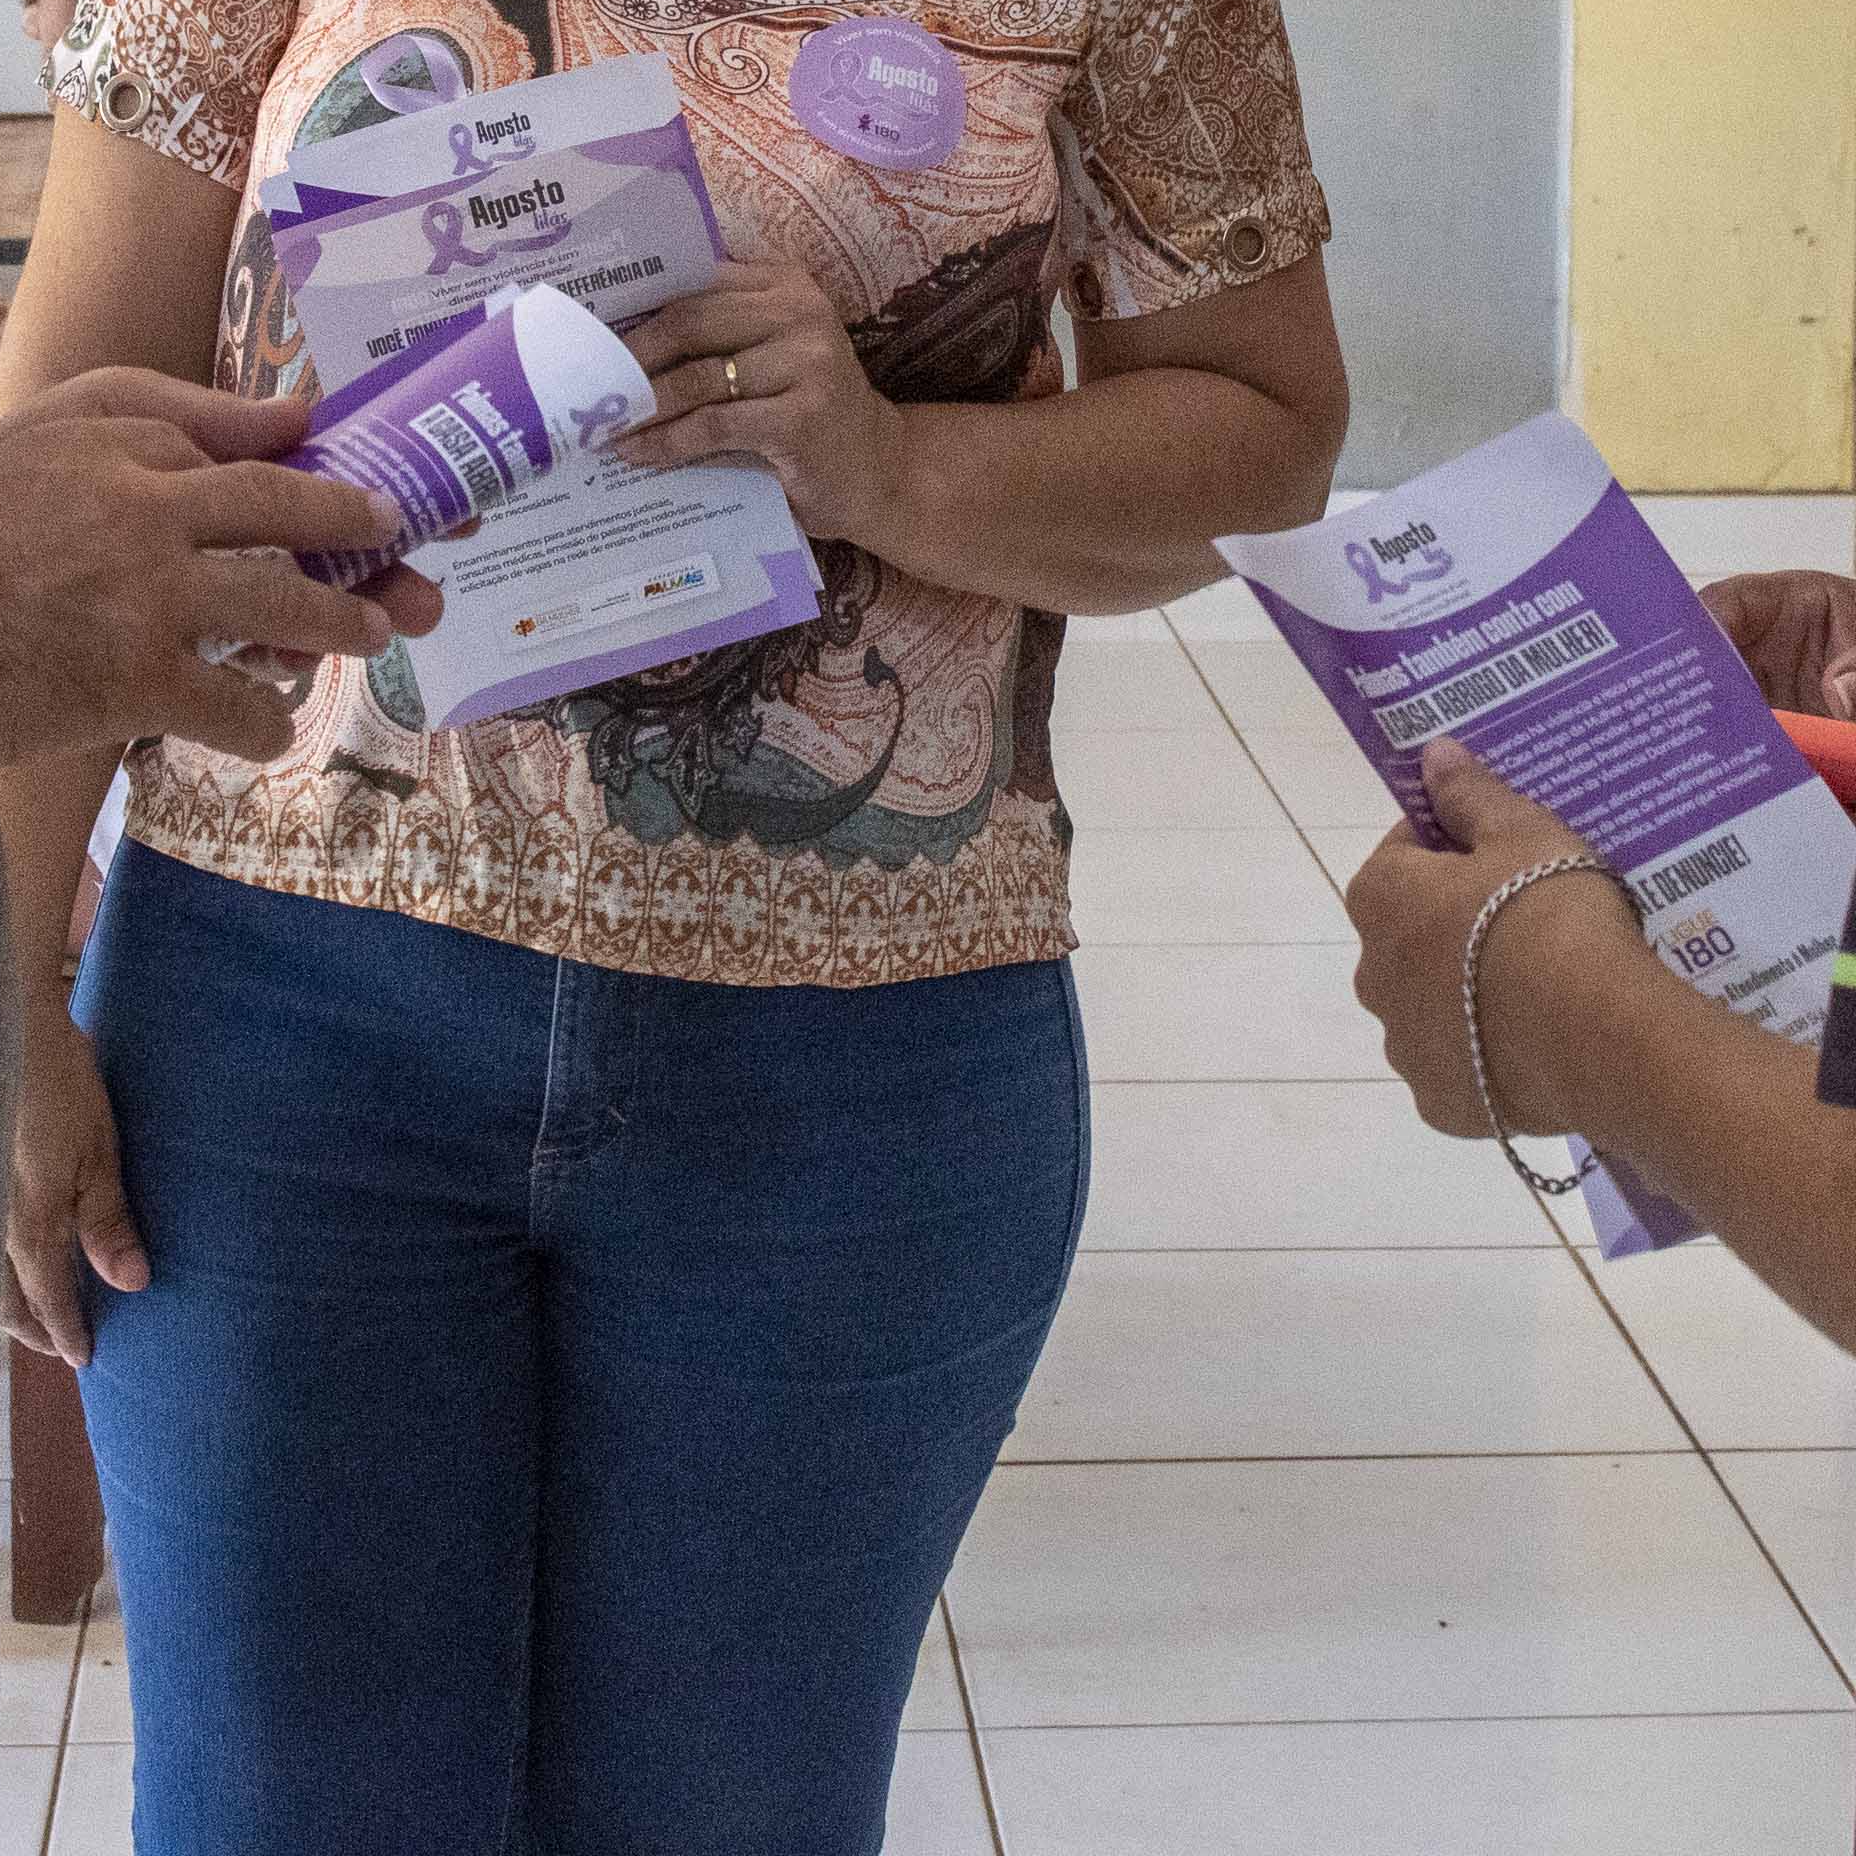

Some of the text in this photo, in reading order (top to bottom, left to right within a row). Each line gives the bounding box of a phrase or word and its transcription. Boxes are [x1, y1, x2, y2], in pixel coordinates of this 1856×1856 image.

[867, 55, 939, 97] Agosto
[475, 111, 532, 145] Agosto
[874, 124, 901, 143] 180
[468, 178, 566, 230] Agosto
[533, 210, 570, 233] lilás
[431, 282, 462, 298] Viver
[464, 276, 491, 289] sem
[492, 258, 546, 281] violência
[447, 287, 487, 306] direito
[366, 327, 405, 359] VOCÊ
[642, 255, 665, 276] DA
[429, 411, 475, 462] CASA
[489, 512, 503, 522] de
[504, 490, 571, 518] necessidades;
[628, 474, 641, 484] de
[451, 496, 673, 571] Encaminhamentos para atendimentos judiciais,
[455, 499, 705, 582] consultas médicas, emissão de passagens rodoviárias,
[458, 572, 509, 596] solicitação
[509, 568, 523, 579] de
[524, 560, 553, 576] vagas
[552, 556, 566, 566] na
[566, 548, 589, 561] rede
[589, 544, 603, 554] de
[603, 534, 637, 550] ensino,
[637, 523, 670, 539] dentre
[671, 514, 703, 529] outros
[1369, 521, 1437, 565] Agosto
[1398, 629, 1490, 681] também
[1479, 599, 1542, 644] conta
[1535, 580, 1585, 619] com
[1387, 697, 1444, 742] CASA
[1435, 661, 1509, 722] ABRIGO
[1501, 652, 1536, 691] DA
[1522, 617, 1610, 679] MULHER!
[1651, 833, 1751, 905] DENUNCIE!
[1671, 926, 1736, 974] 180
